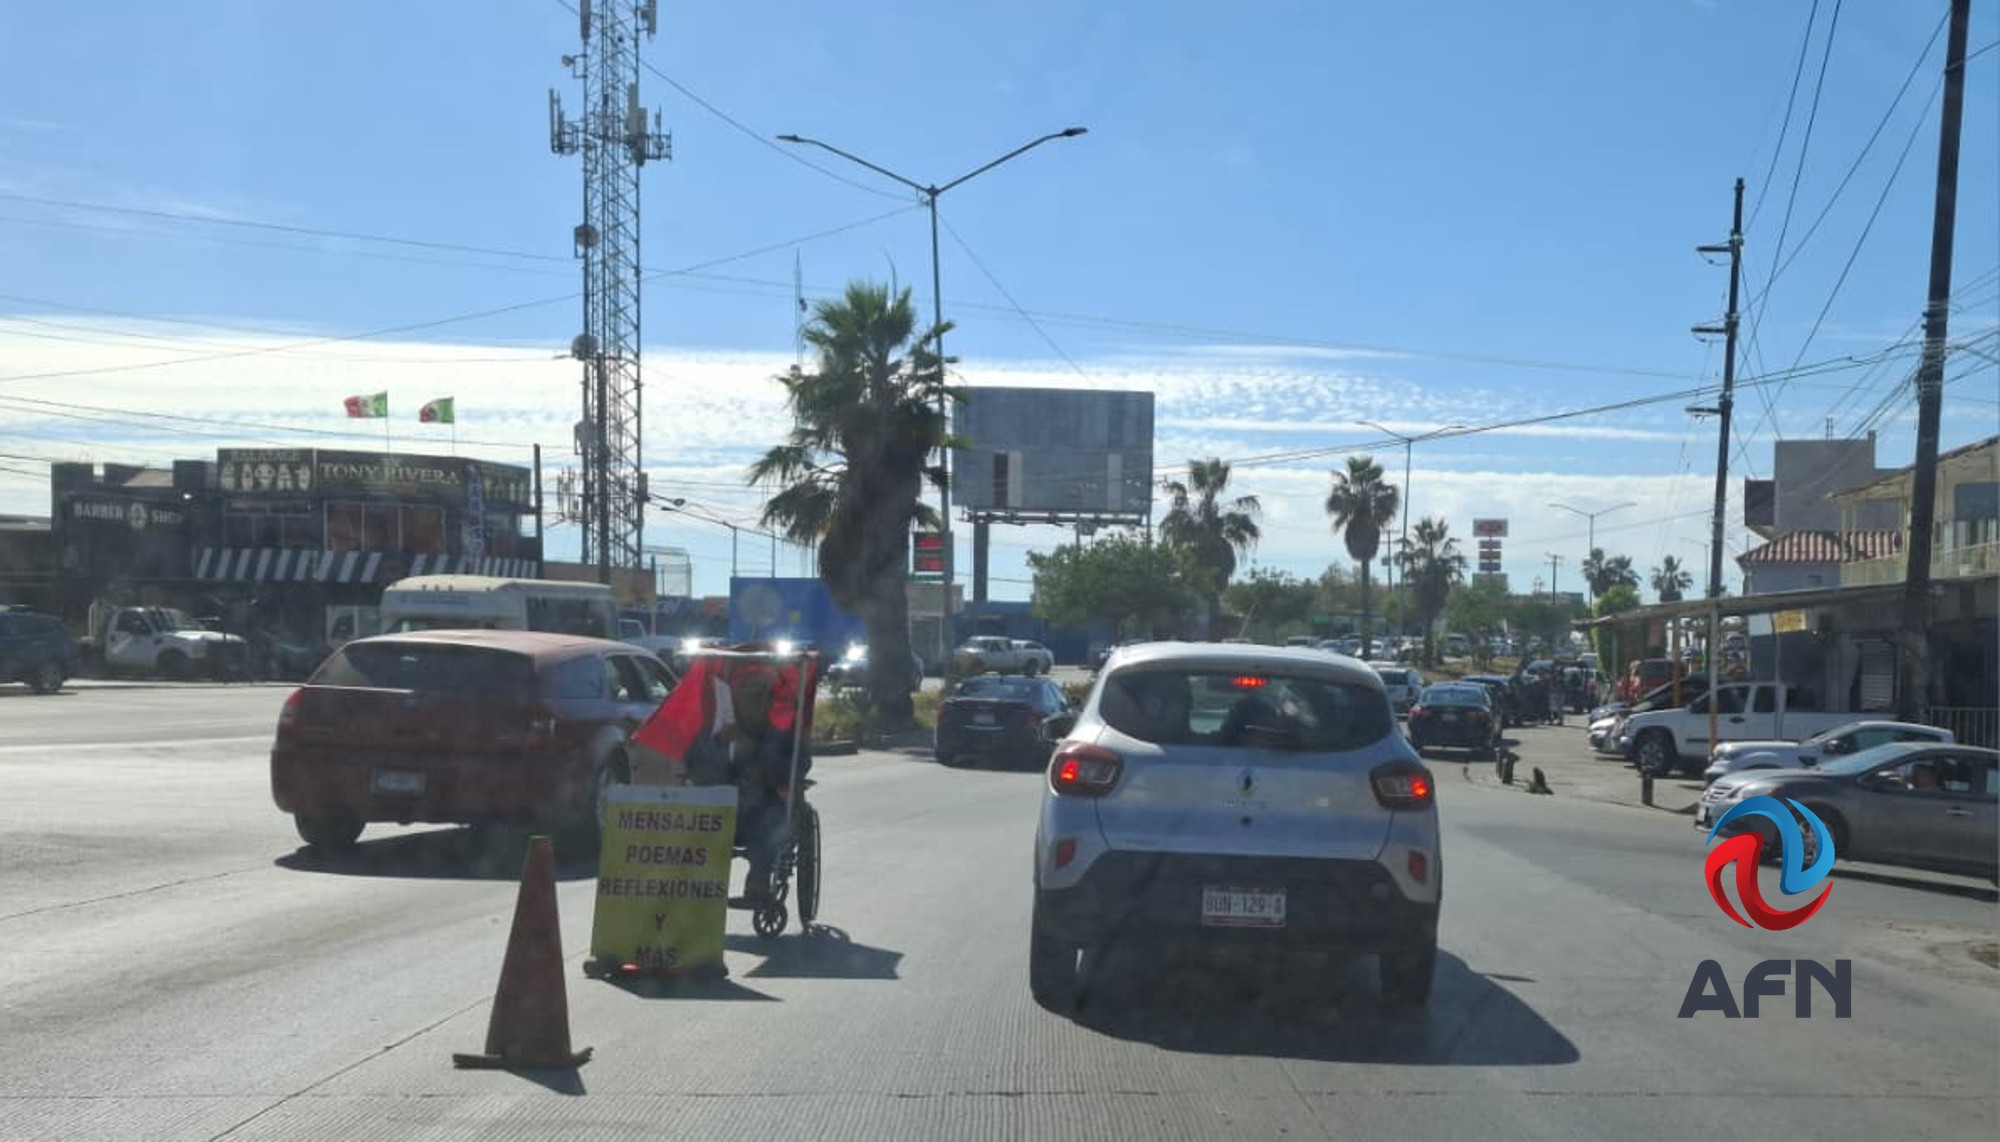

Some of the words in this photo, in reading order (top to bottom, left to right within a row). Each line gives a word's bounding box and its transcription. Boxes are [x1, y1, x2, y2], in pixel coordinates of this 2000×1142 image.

[319, 463, 377, 480] TONY
[384, 465, 460, 485] RIVERA
[73, 502, 124, 520] BARBER
[618, 811, 723, 832] MENSAJES
[626, 845, 708, 866] POEMAS
[599, 878, 727, 899] REFLEXIONES
[654, 912, 667, 932] Y
[635, 947, 679, 968] MAS
